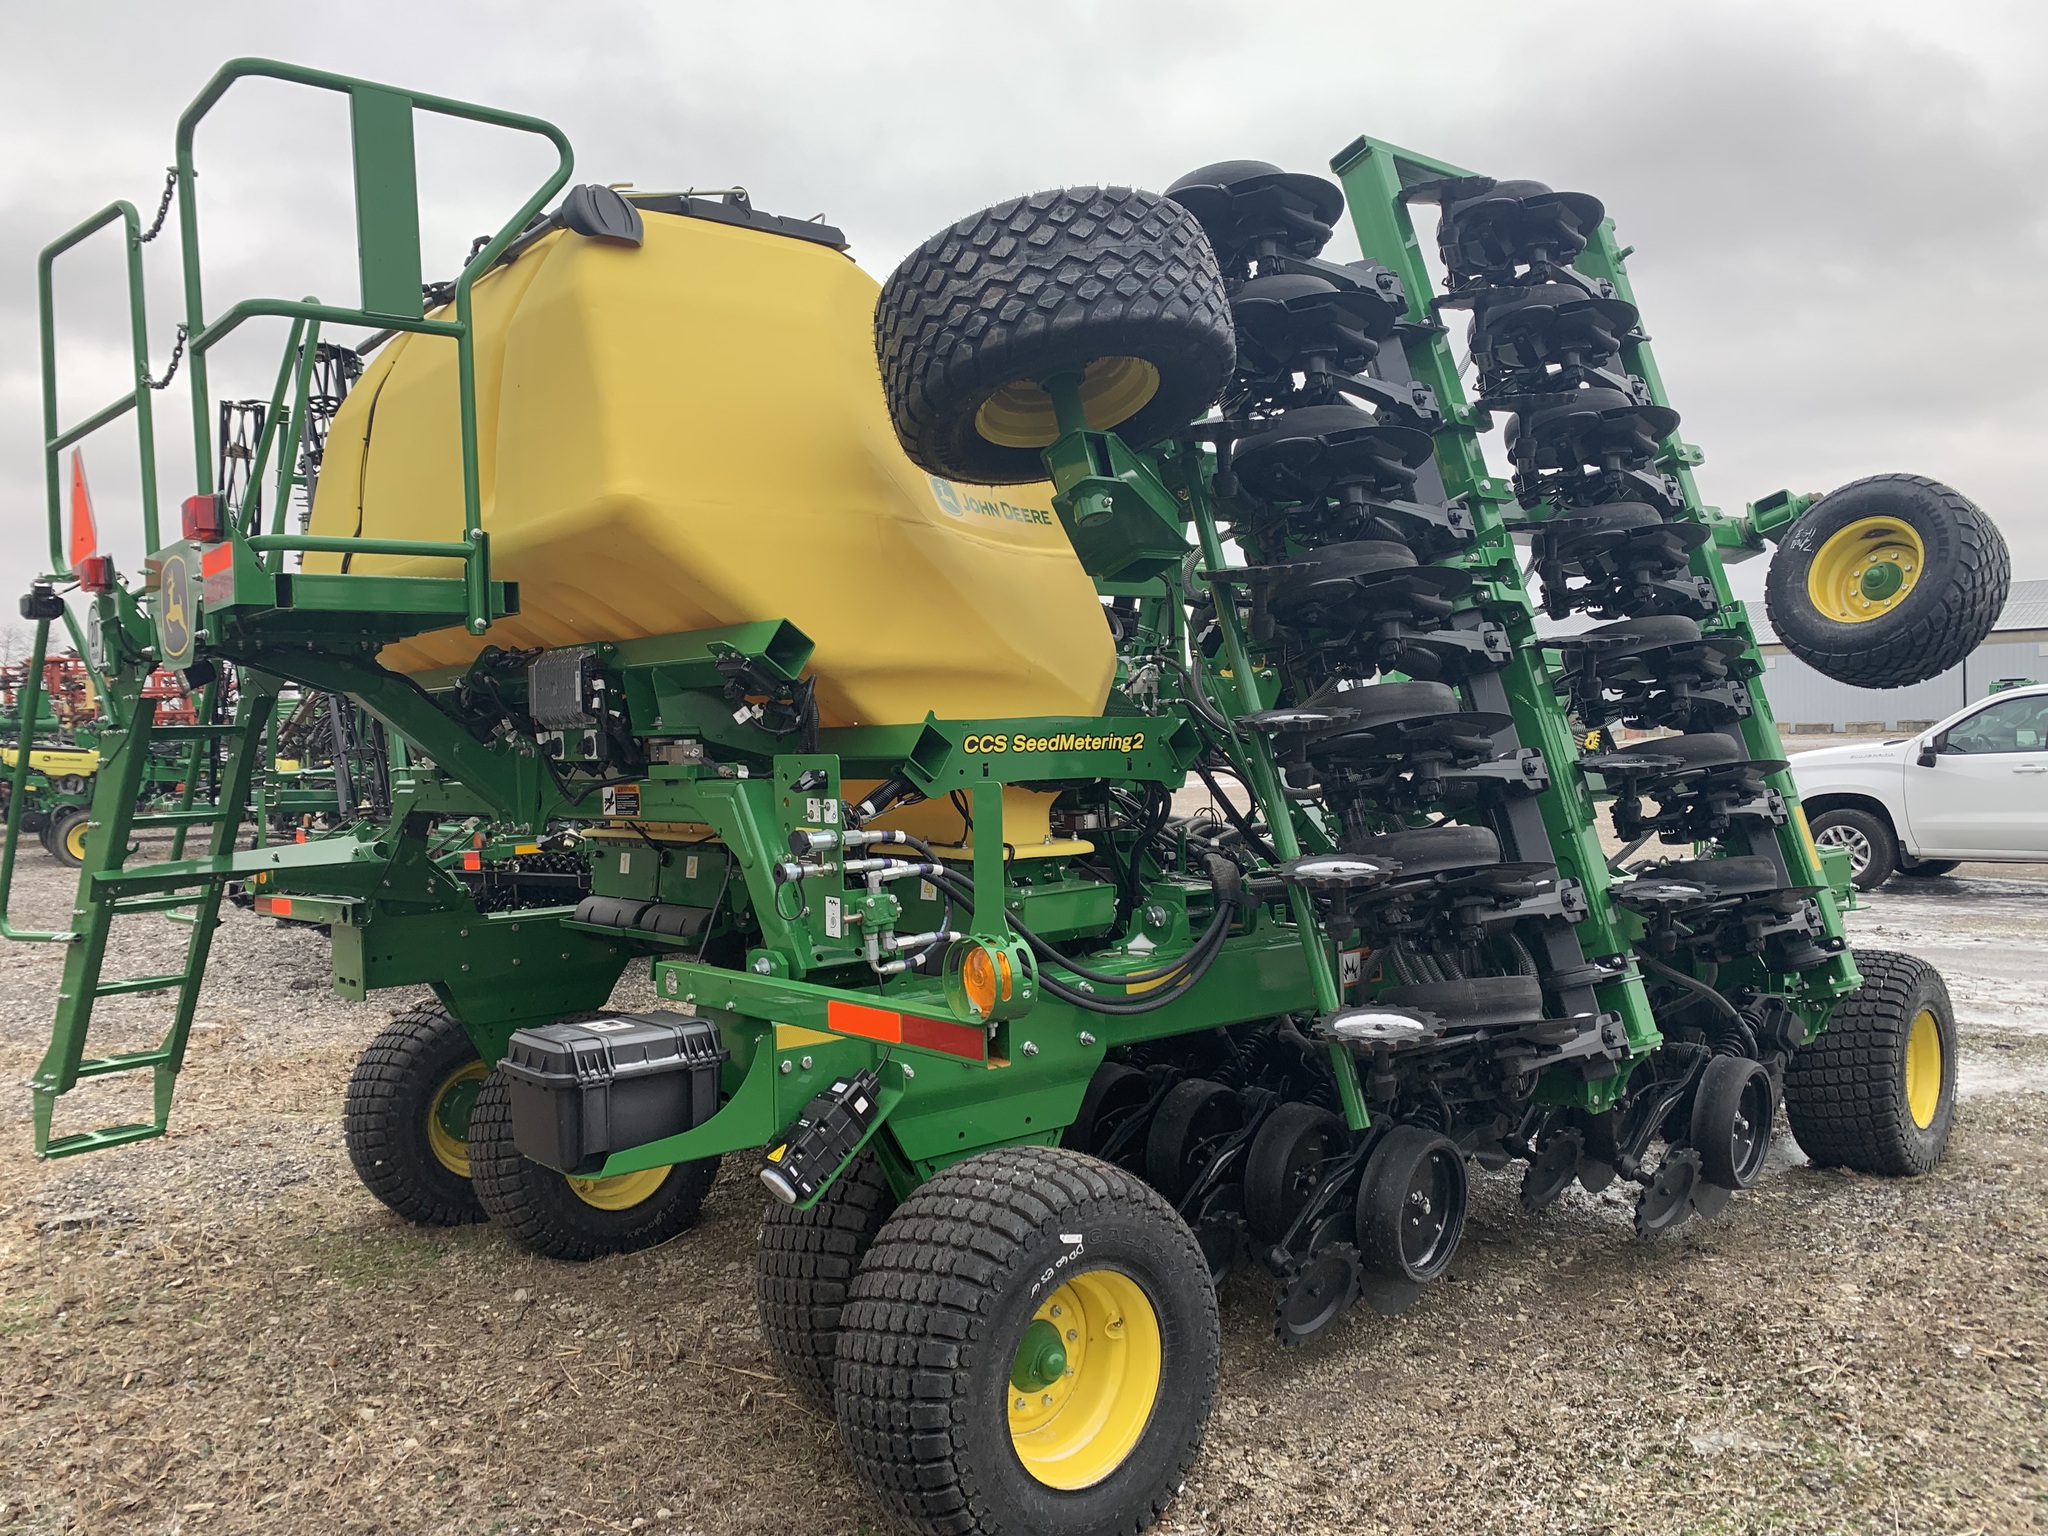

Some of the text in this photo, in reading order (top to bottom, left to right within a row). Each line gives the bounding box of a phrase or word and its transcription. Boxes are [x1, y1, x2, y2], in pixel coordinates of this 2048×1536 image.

[963, 493, 1052, 525] JOHN DEERE
[963, 732, 1145, 754] CCS SeedMetering2
[687, 858, 696, 876] 2
[923, 882, 934, 898] 4
[1088, 1228, 1178, 1276] GALAXY
